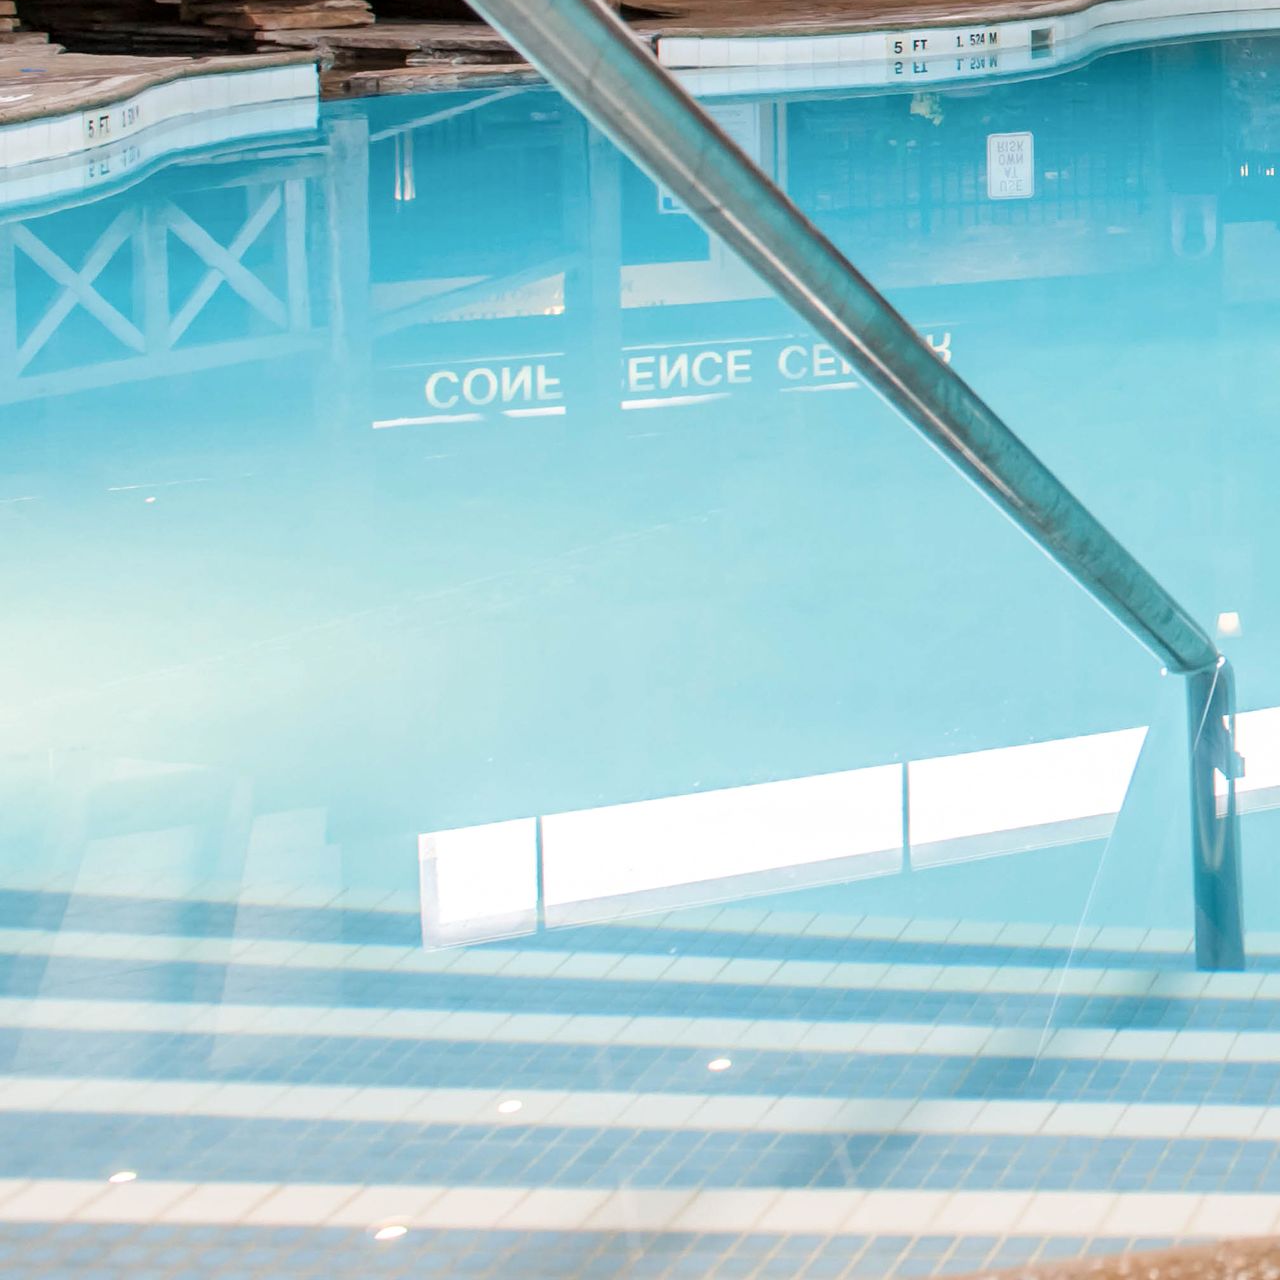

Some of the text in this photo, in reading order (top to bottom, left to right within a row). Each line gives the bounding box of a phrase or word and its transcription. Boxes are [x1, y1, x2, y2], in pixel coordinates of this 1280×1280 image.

[894, 41, 903, 54] 5
[913, 39, 928, 51] FT
[970, 33, 985, 46] 524
[989, 32, 997, 44] M
